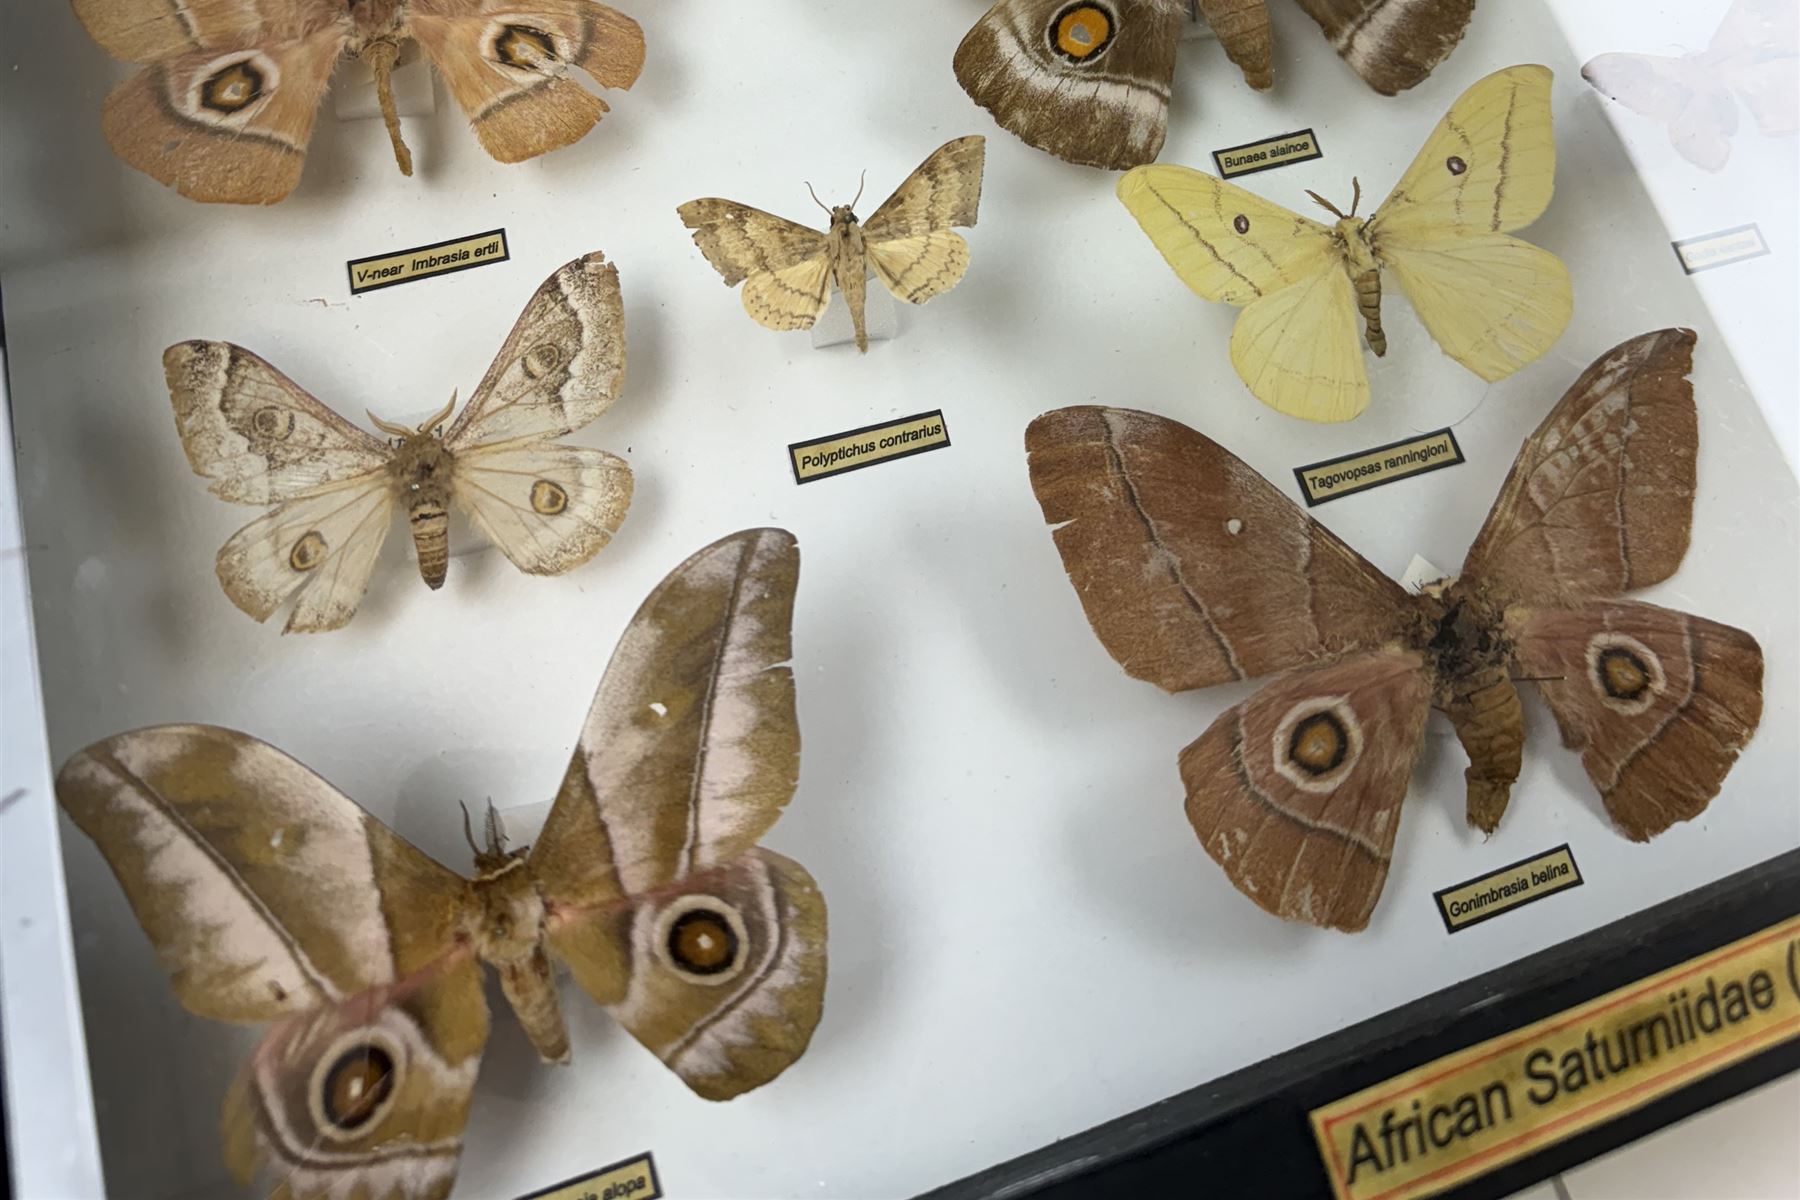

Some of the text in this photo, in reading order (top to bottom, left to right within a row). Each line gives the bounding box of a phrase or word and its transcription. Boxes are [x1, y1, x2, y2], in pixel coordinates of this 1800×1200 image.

[1224, 151, 1267, 168] Bunaea
[357, 264, 404, 283] V-near
[412, 249, 470, 272] Imbrasia
[802, 424, 942, 469] Polyptichus contrarius
[1309, 461, 1382, 490] Tagovopsas
[1449, 862, 1569, 917] Gonimbrasia belina
[1346, 1077, 1514, 1185] African
[1523, 968, 1776, 1106] Saturniidae
